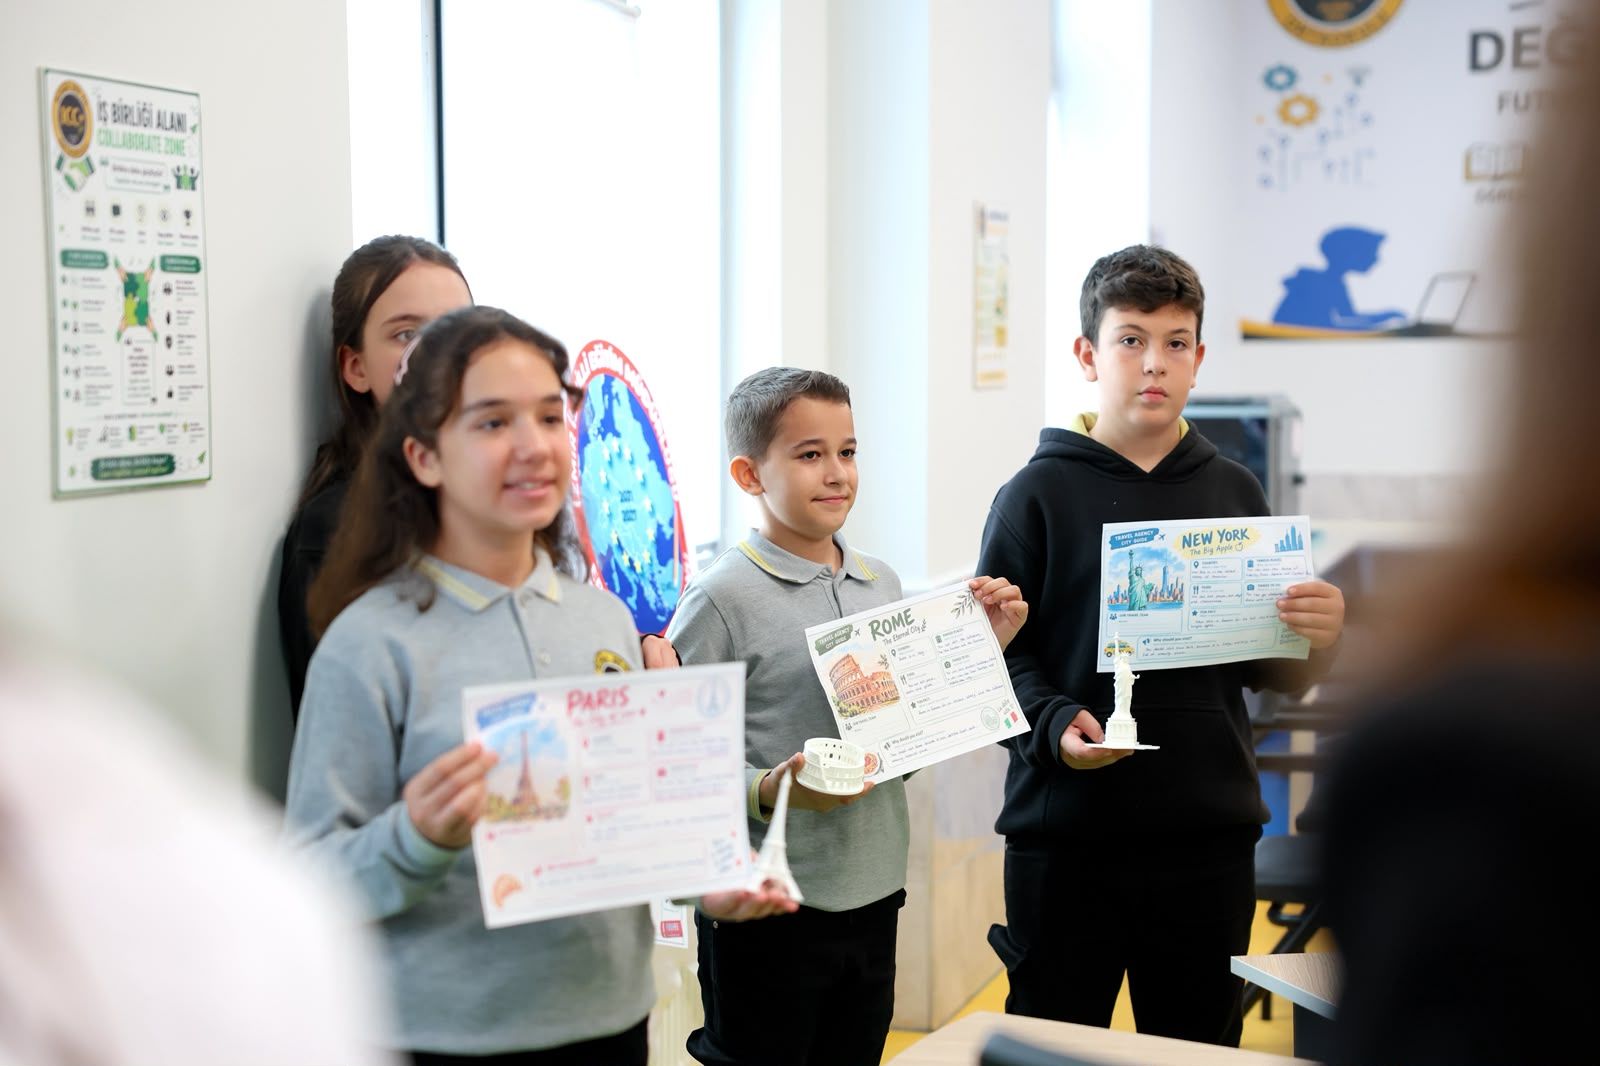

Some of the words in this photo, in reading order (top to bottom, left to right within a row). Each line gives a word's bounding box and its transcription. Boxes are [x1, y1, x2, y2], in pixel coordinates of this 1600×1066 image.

[156, 109, 187, 134] ALANI
[1114, 533, 1133, 541] TRAVEL
[1134, 530, 1153, 538] AGENCY
[1182, 530, 1213, 549] NEW
[1217, 528, 1250, 544] YORK
[1204, 546, 1213, 555] Big
[1216, 544, 1233, 553] Apple
[868, 608, 915, 641] ROME
[882, 638, 892, 646] The
[893, 629, 909, 641] Eternal
[910, 625, 921, 634] City
[566, 685, 630, 718] PARIS
